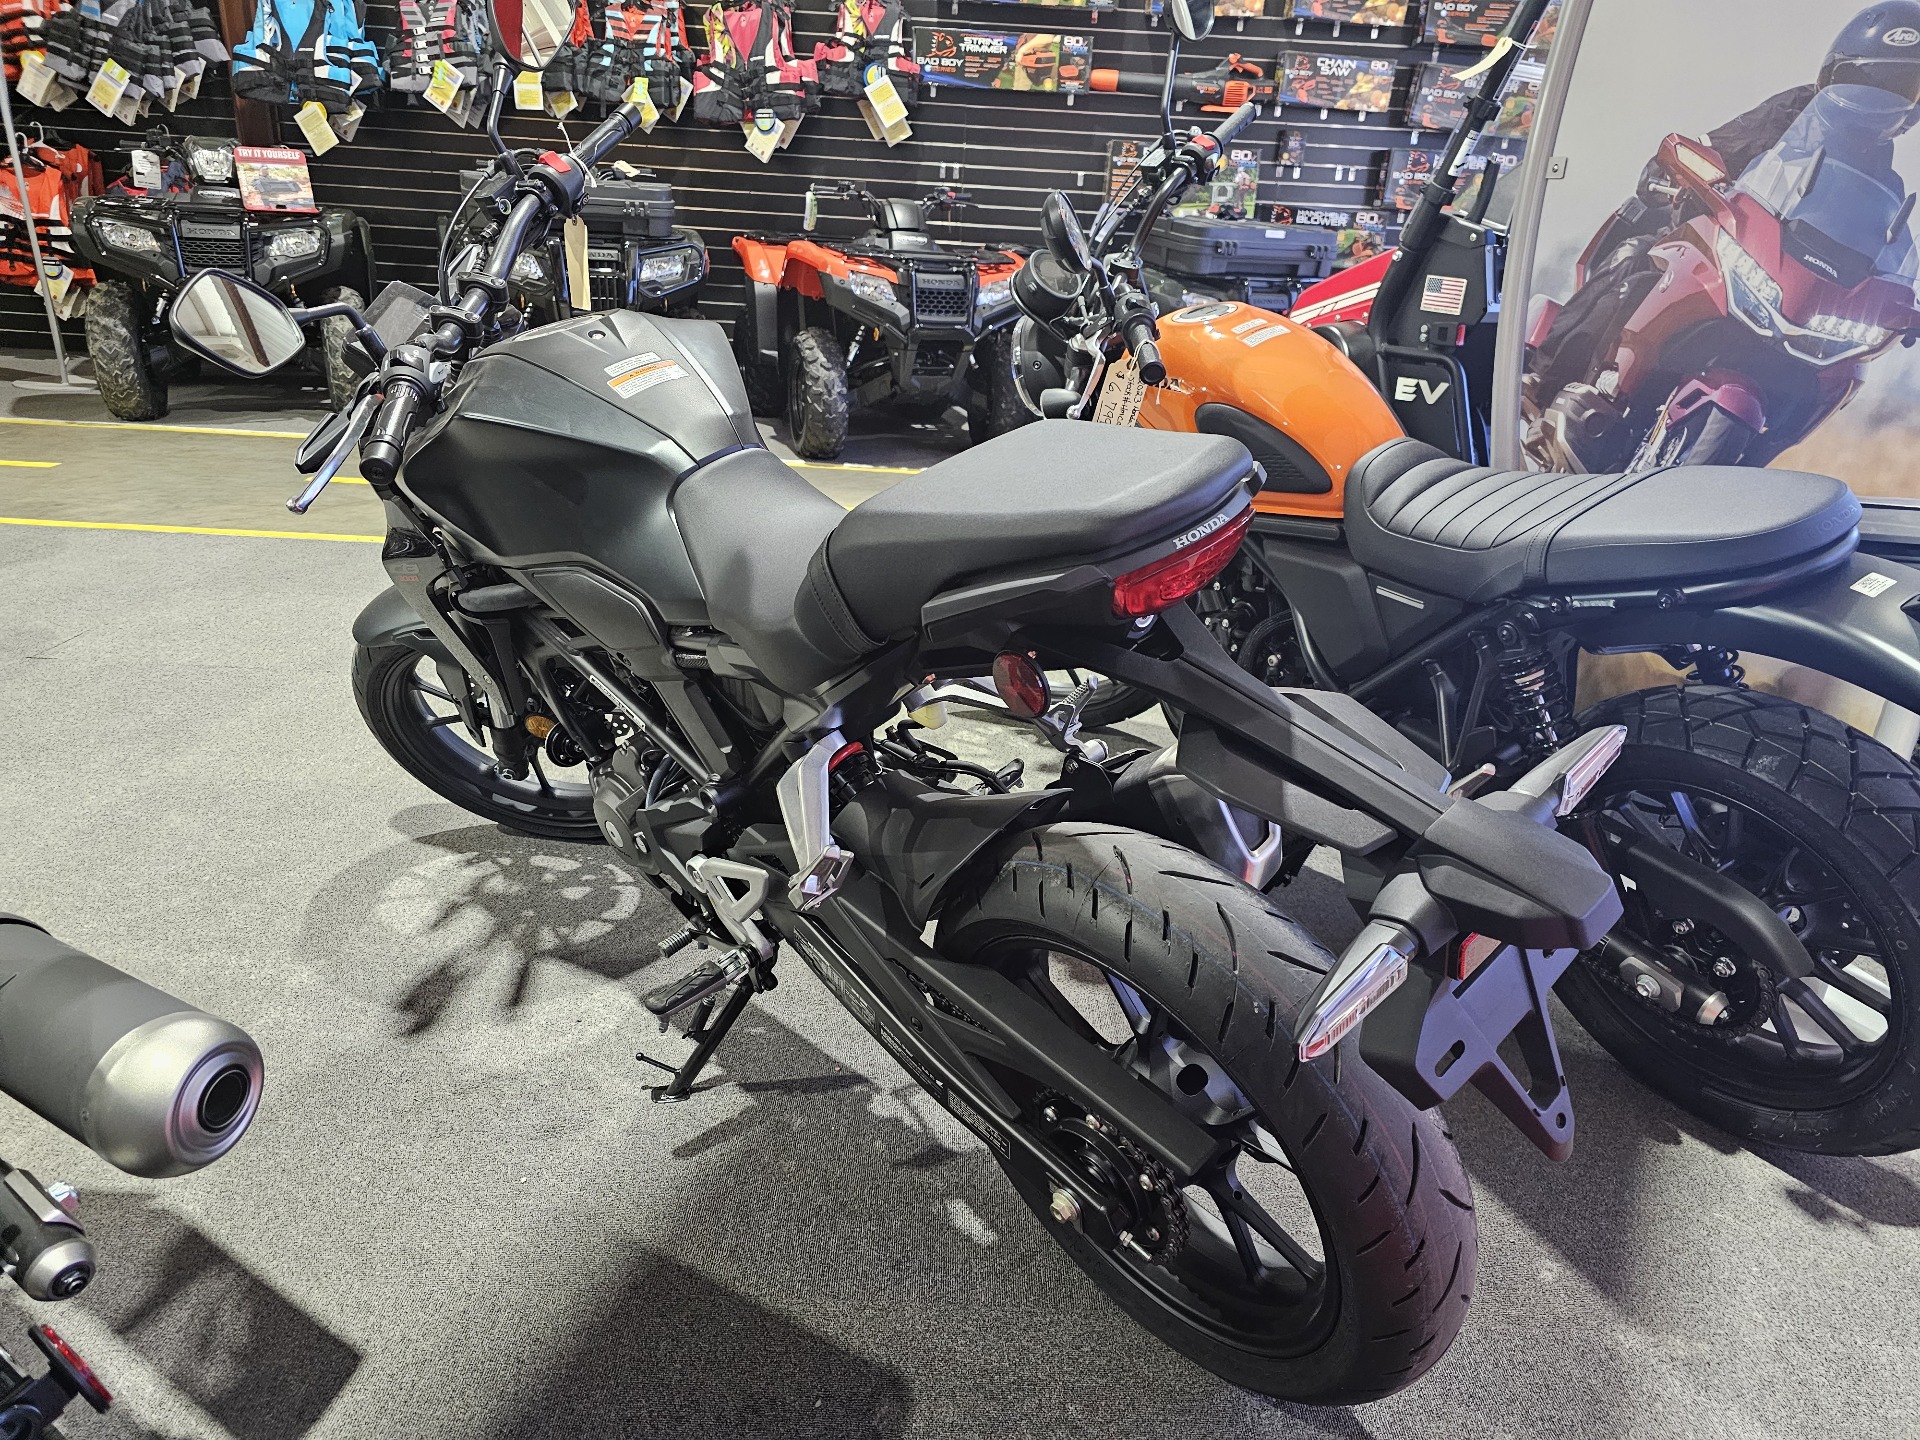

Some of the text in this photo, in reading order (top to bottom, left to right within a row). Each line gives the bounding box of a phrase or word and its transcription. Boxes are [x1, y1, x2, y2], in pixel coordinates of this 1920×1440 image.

[1433, 2, 1478, 12] BAD BOY
[963, 36, 1003, 46] STRING
[959, 43, 1008, 54] TRIMMER
[916, 56, 939, 65] BAD
[941, 58, 964, 67] BOY
[1316, 57, 1358, 69] CHAIN
[1320, 66, 1352, 76] SAW
[1421, 87, 1465, 99] BAD BOY
[237, 148, 300, 160] TRY IT YOURSELF
[1393, 172, 1413, 180] BAD
[1296, 214, 1348, 227] BLOWER
[187, 228, 237, 236] HONDA
[1803, 254, 1838, 278] HONDA
[922, 278, 960, 286] HONDA
[1394, 376, 1450, 405] EV
[1172, 512, 1230, 550] HONDA
